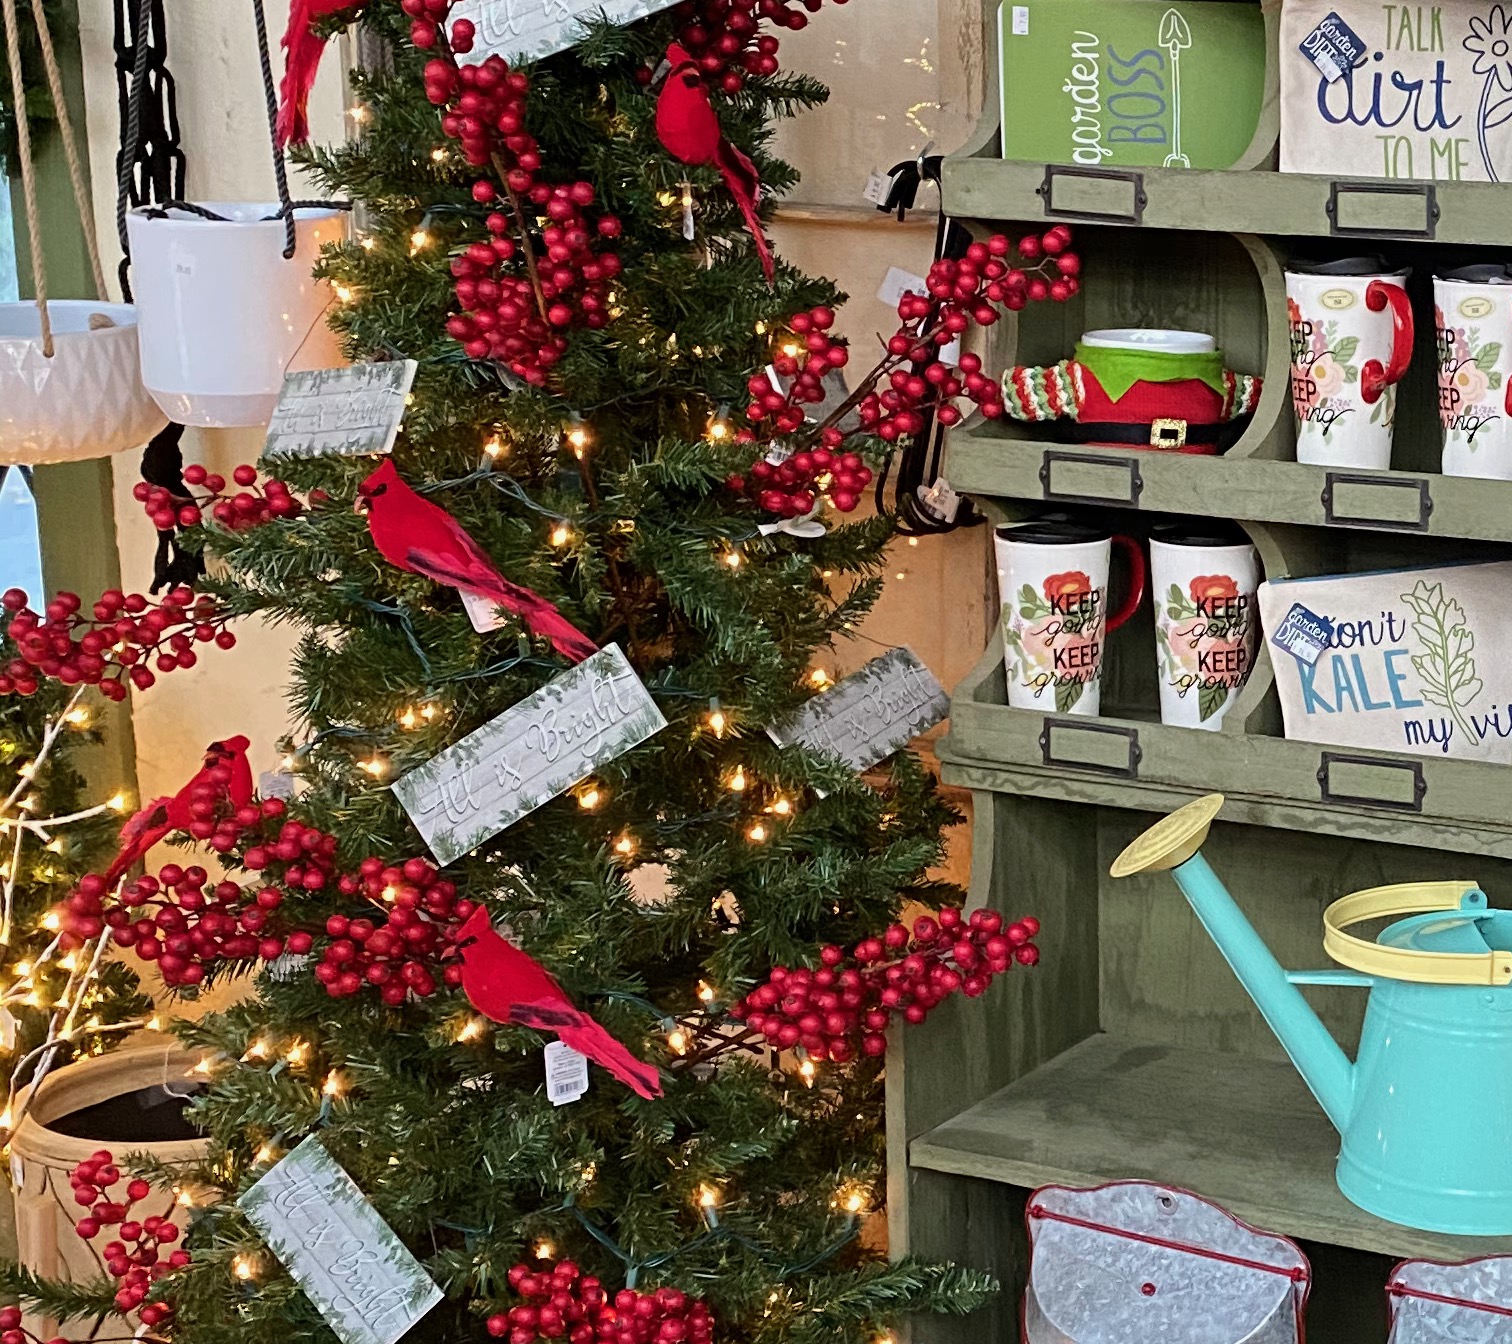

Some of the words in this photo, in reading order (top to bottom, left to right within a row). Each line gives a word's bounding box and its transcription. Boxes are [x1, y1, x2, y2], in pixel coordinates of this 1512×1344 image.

[1320, 19, 1357, 61] garden
[1382, 5, 1444, 52] TALK
[1062, 30, 1113, 165] garden
[1107, 44, 1167, 144] BOSS
[1317, 52, 1462, 132] dirt
[1375, 135, 1413, 178] TO
[1050, 590, 1100, 616] KEEP
[1196, 595, 1247, 618] KEEP
[1030, 615, 1103, 647] going
[1176, 619, 1248, 649] going
[1287, 611, 1328, 643] garden
[1053, 643, 1099, 670] KEEP
[1198, 648, 1247, 673] KEEP
[864, 664, 932, 725] Bright
[1297, 649, 1423, 714] KALE
[419, 760, 480, 828] All
[494, 757, 522, 791] is
[525, 672, 633, 762] Bright
[1404, 718, 1453, 752] my
[272, 1167, 334, 1219] All
[303, 1218, 334, 1250] is
[329, 1240, 412, 1330] Bright
